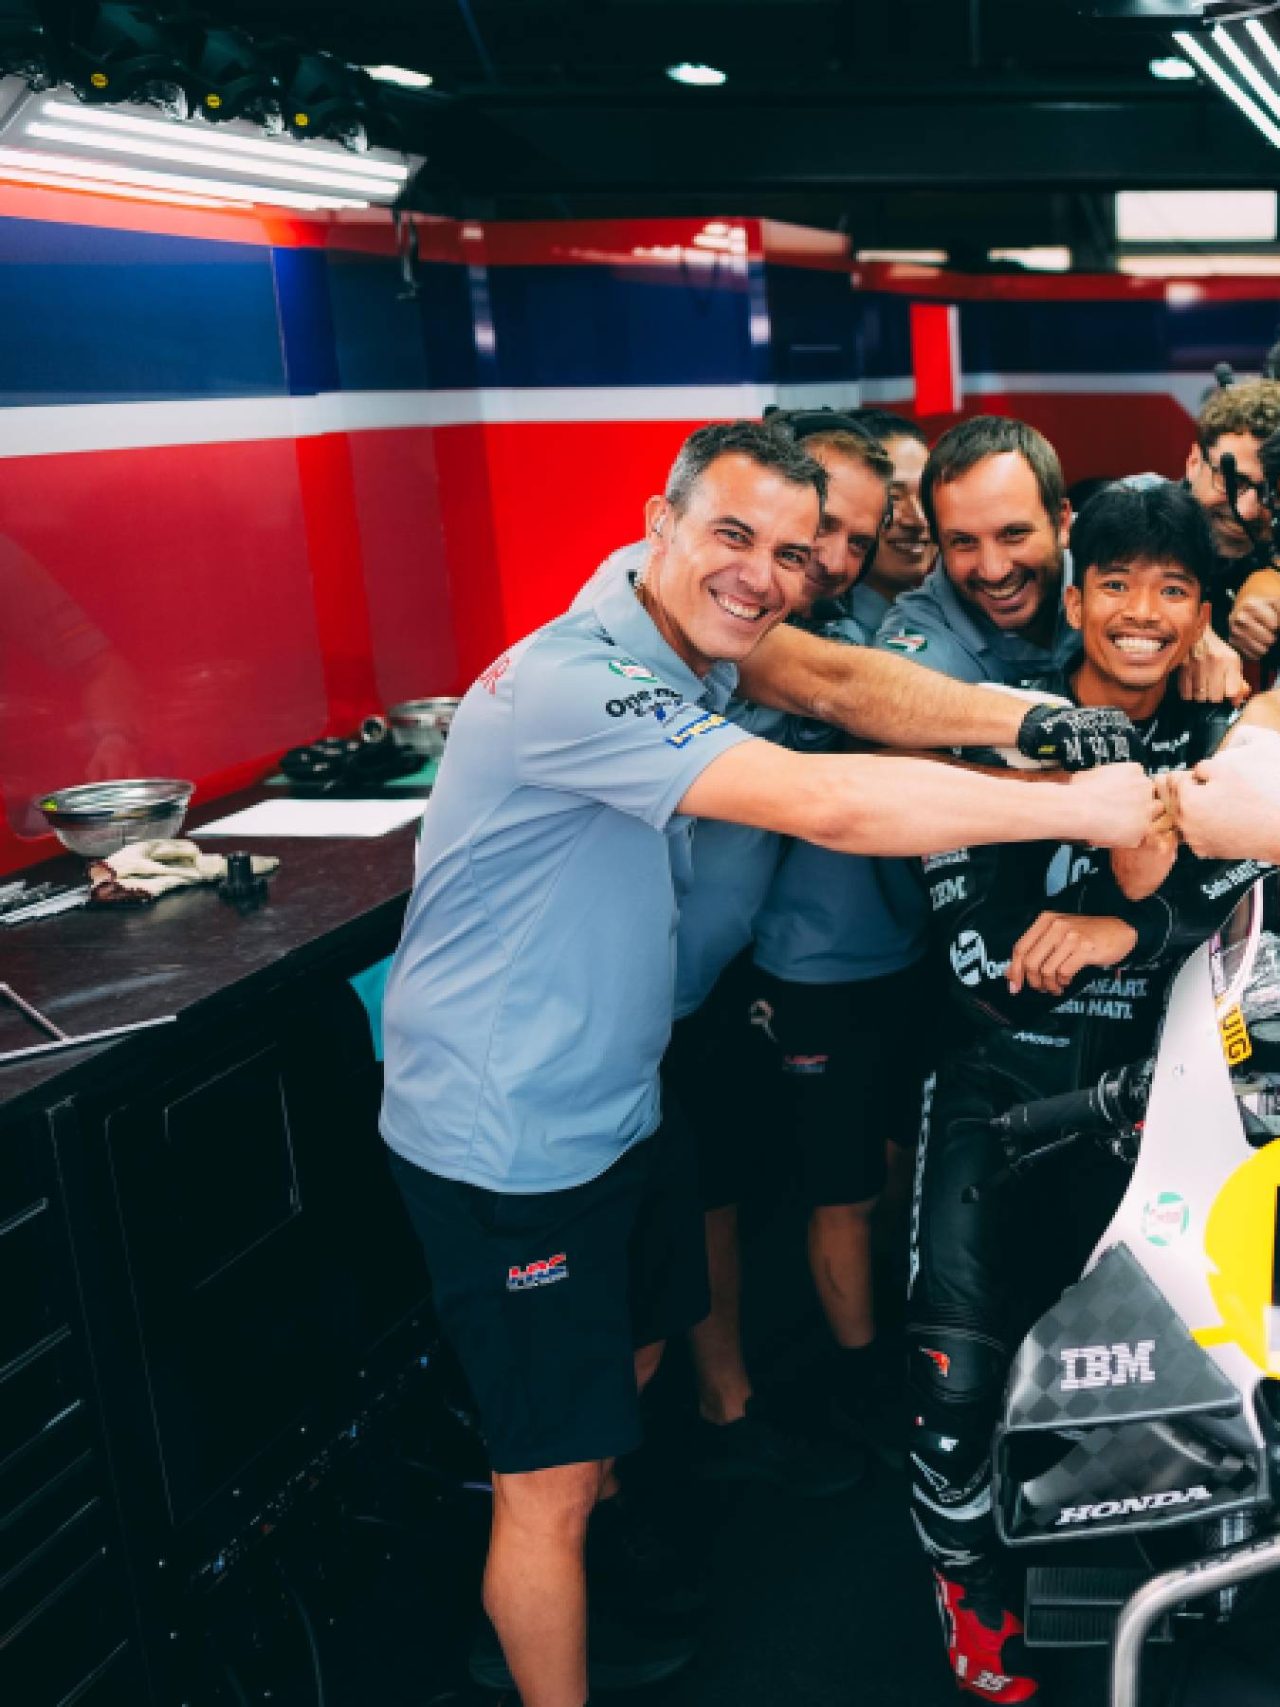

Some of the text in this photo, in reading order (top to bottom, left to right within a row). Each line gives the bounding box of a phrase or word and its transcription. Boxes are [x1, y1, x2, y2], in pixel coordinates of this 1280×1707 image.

[1222, 1006, 1247, 1059] UIG
[506, 1251, 569, 1292] HRC
[1061, 1340, 1155, 1391] IBM
[1055, 1485, 1213, 1526] HONDA
